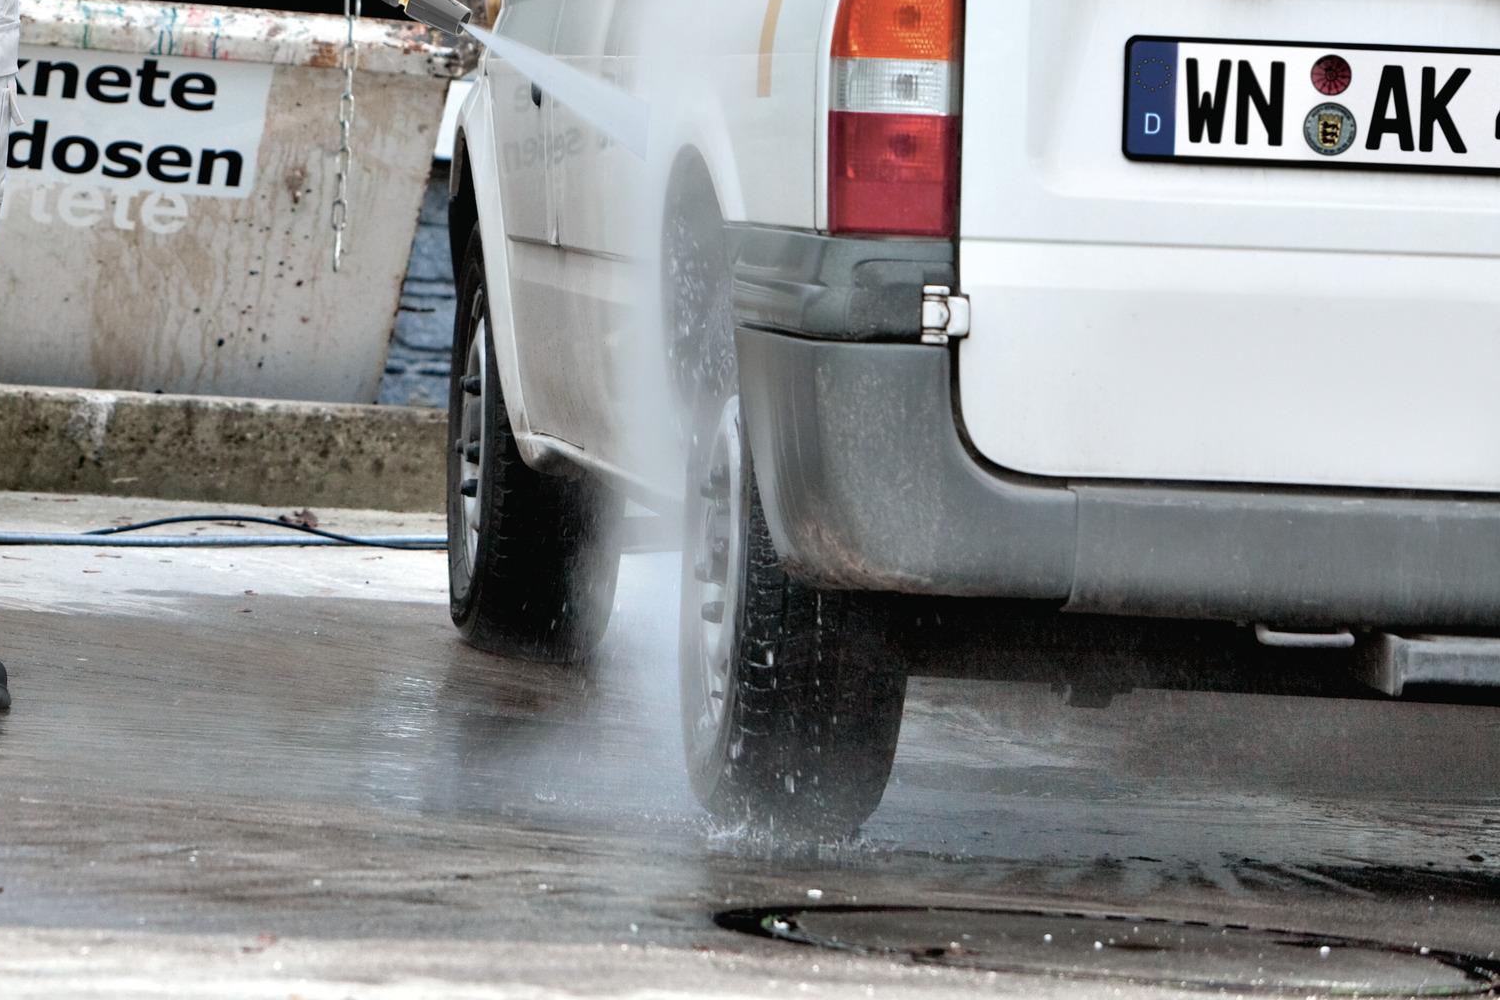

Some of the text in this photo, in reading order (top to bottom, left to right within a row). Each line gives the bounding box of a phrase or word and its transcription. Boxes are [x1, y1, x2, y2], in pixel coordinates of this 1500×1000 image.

[1143, 111, 1162, 136] D
[1186, 57, 1286, 147] WN
[1365, 64, 1472, 154] AK
[6, 119, 244, 187] dosen
